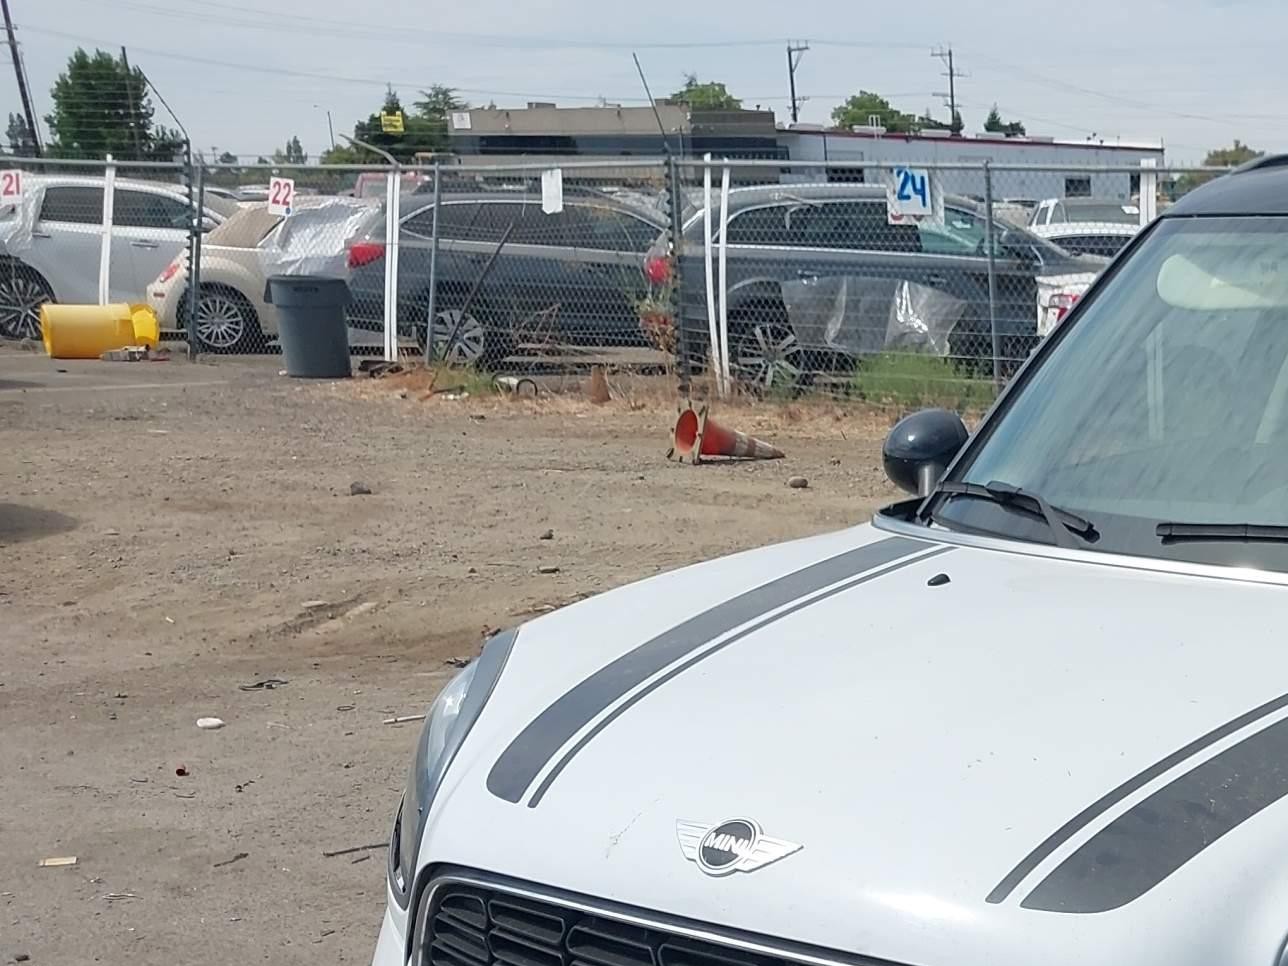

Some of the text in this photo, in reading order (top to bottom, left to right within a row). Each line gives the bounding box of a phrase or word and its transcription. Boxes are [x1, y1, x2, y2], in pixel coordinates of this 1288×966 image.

[2, 173, 20, 196] 21
[271, 180, 292, 206] 22
[895, 166, 927, 208] 24
[703, 832, 751, 857] MINI
